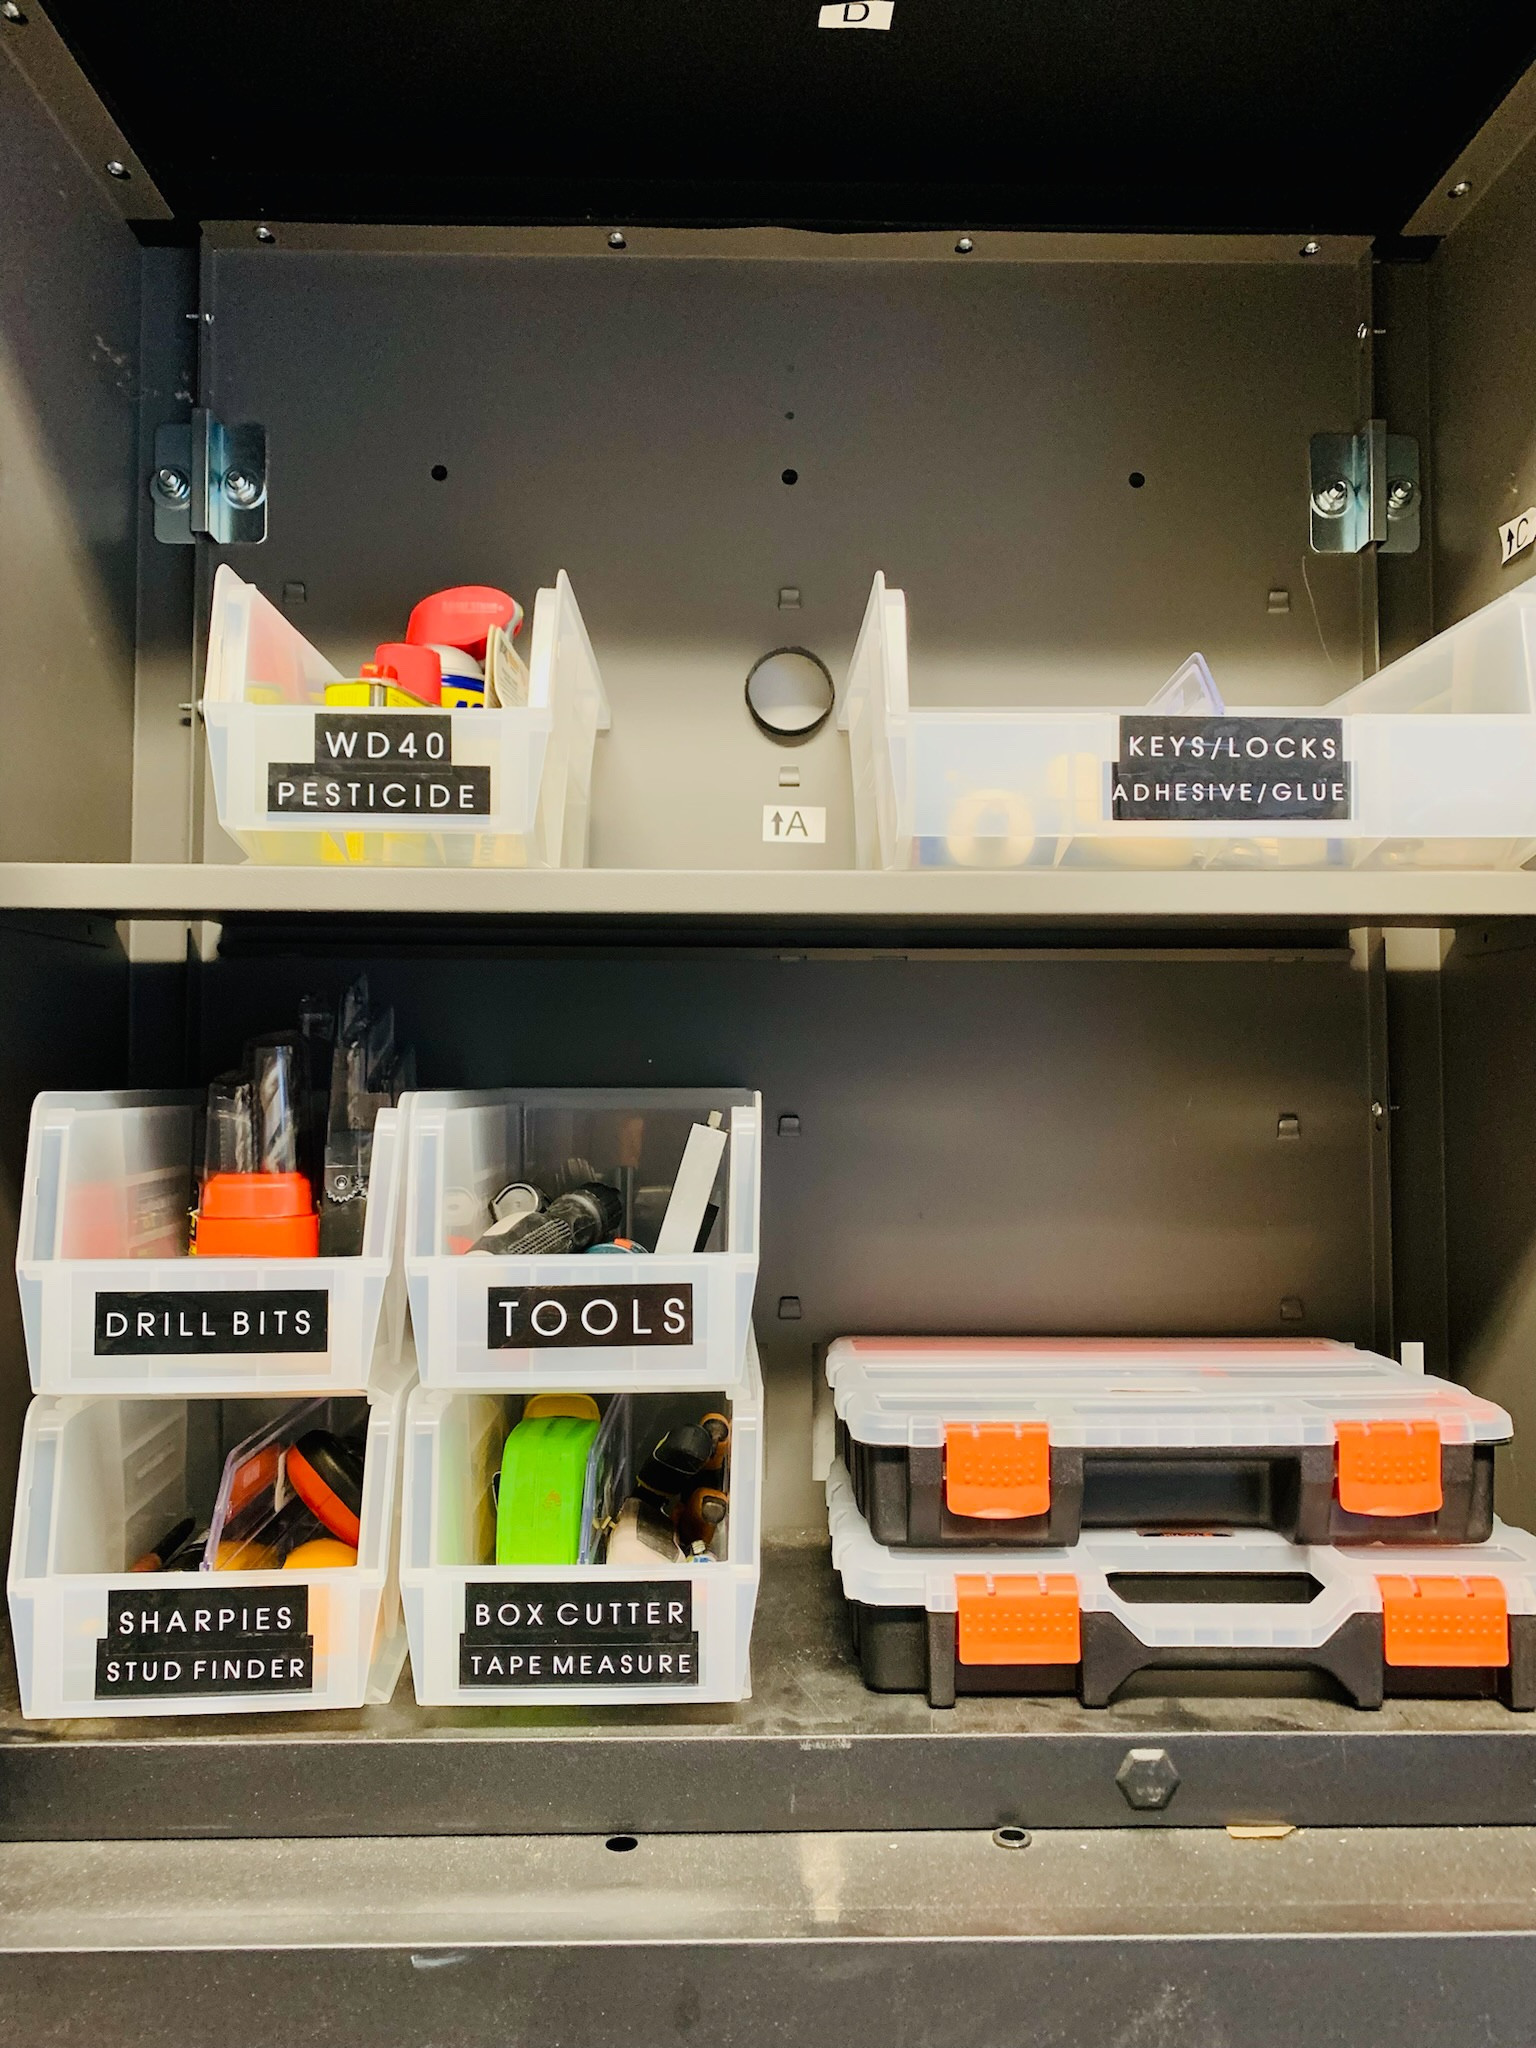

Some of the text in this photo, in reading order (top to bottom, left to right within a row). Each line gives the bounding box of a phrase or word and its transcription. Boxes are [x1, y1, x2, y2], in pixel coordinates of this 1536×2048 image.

[843, 2, 870, 22] D
[1516, 517, 1529, 548] C
[325, 731, 444, 759] WD40
[1129, 735, 1336, 760] KEYS/LOCKS
[278, 782, 474, 808] PESTICIDE
[1112, 782, 1344, 803] ADHESIVE/GLUE
[785, 810, 809, 837] A
[106, 1309, 311, 1337] DRILL BITS
[498, 1297, 685, 1337] TOOLS
[119, 1606, 292, 1635] SHARPIES
[475, 1601, 684, 1626] BOX CUTTER
[106, 1658, 304, 1682] STUD FINDER
[470, 1654, 691, 1676] TAPE MEASURE
